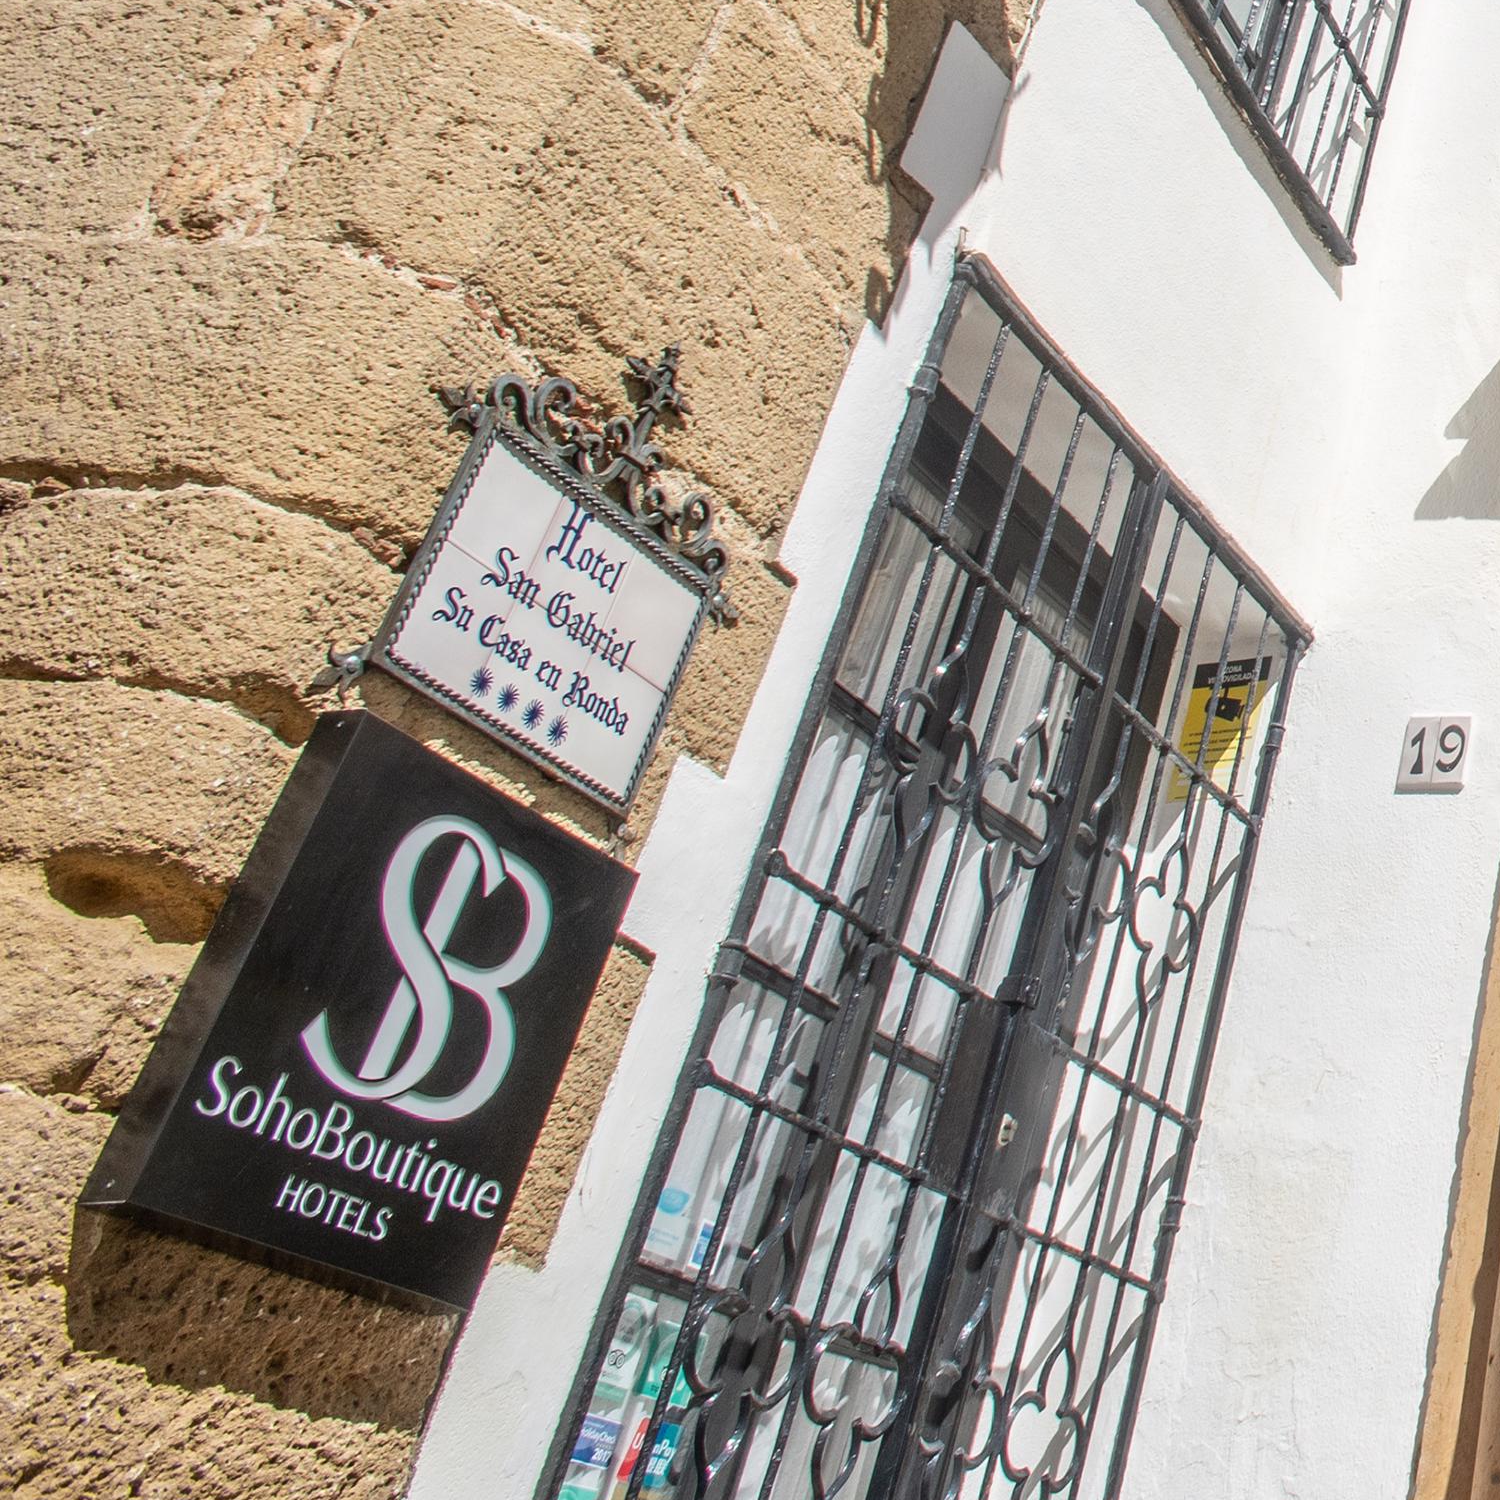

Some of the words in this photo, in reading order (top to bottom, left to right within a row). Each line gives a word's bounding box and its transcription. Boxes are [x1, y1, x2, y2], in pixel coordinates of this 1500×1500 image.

[546, 500, 628, 594] Hotel
[481, 546, 541, 609] San
[547, 590, 637, 673] Gabriel
[479, 614, 533, 671] Casa
[535, 657, 563, 691] en
[562, 670, 629, 736] Ronda
[1410, 724, 1466, 774] 19
[195, 1055, 501, 1222] SohoBoutique
[275, 1173, 394, 1242] HOTELS
[591, 1447, 613, 1463] 2017
